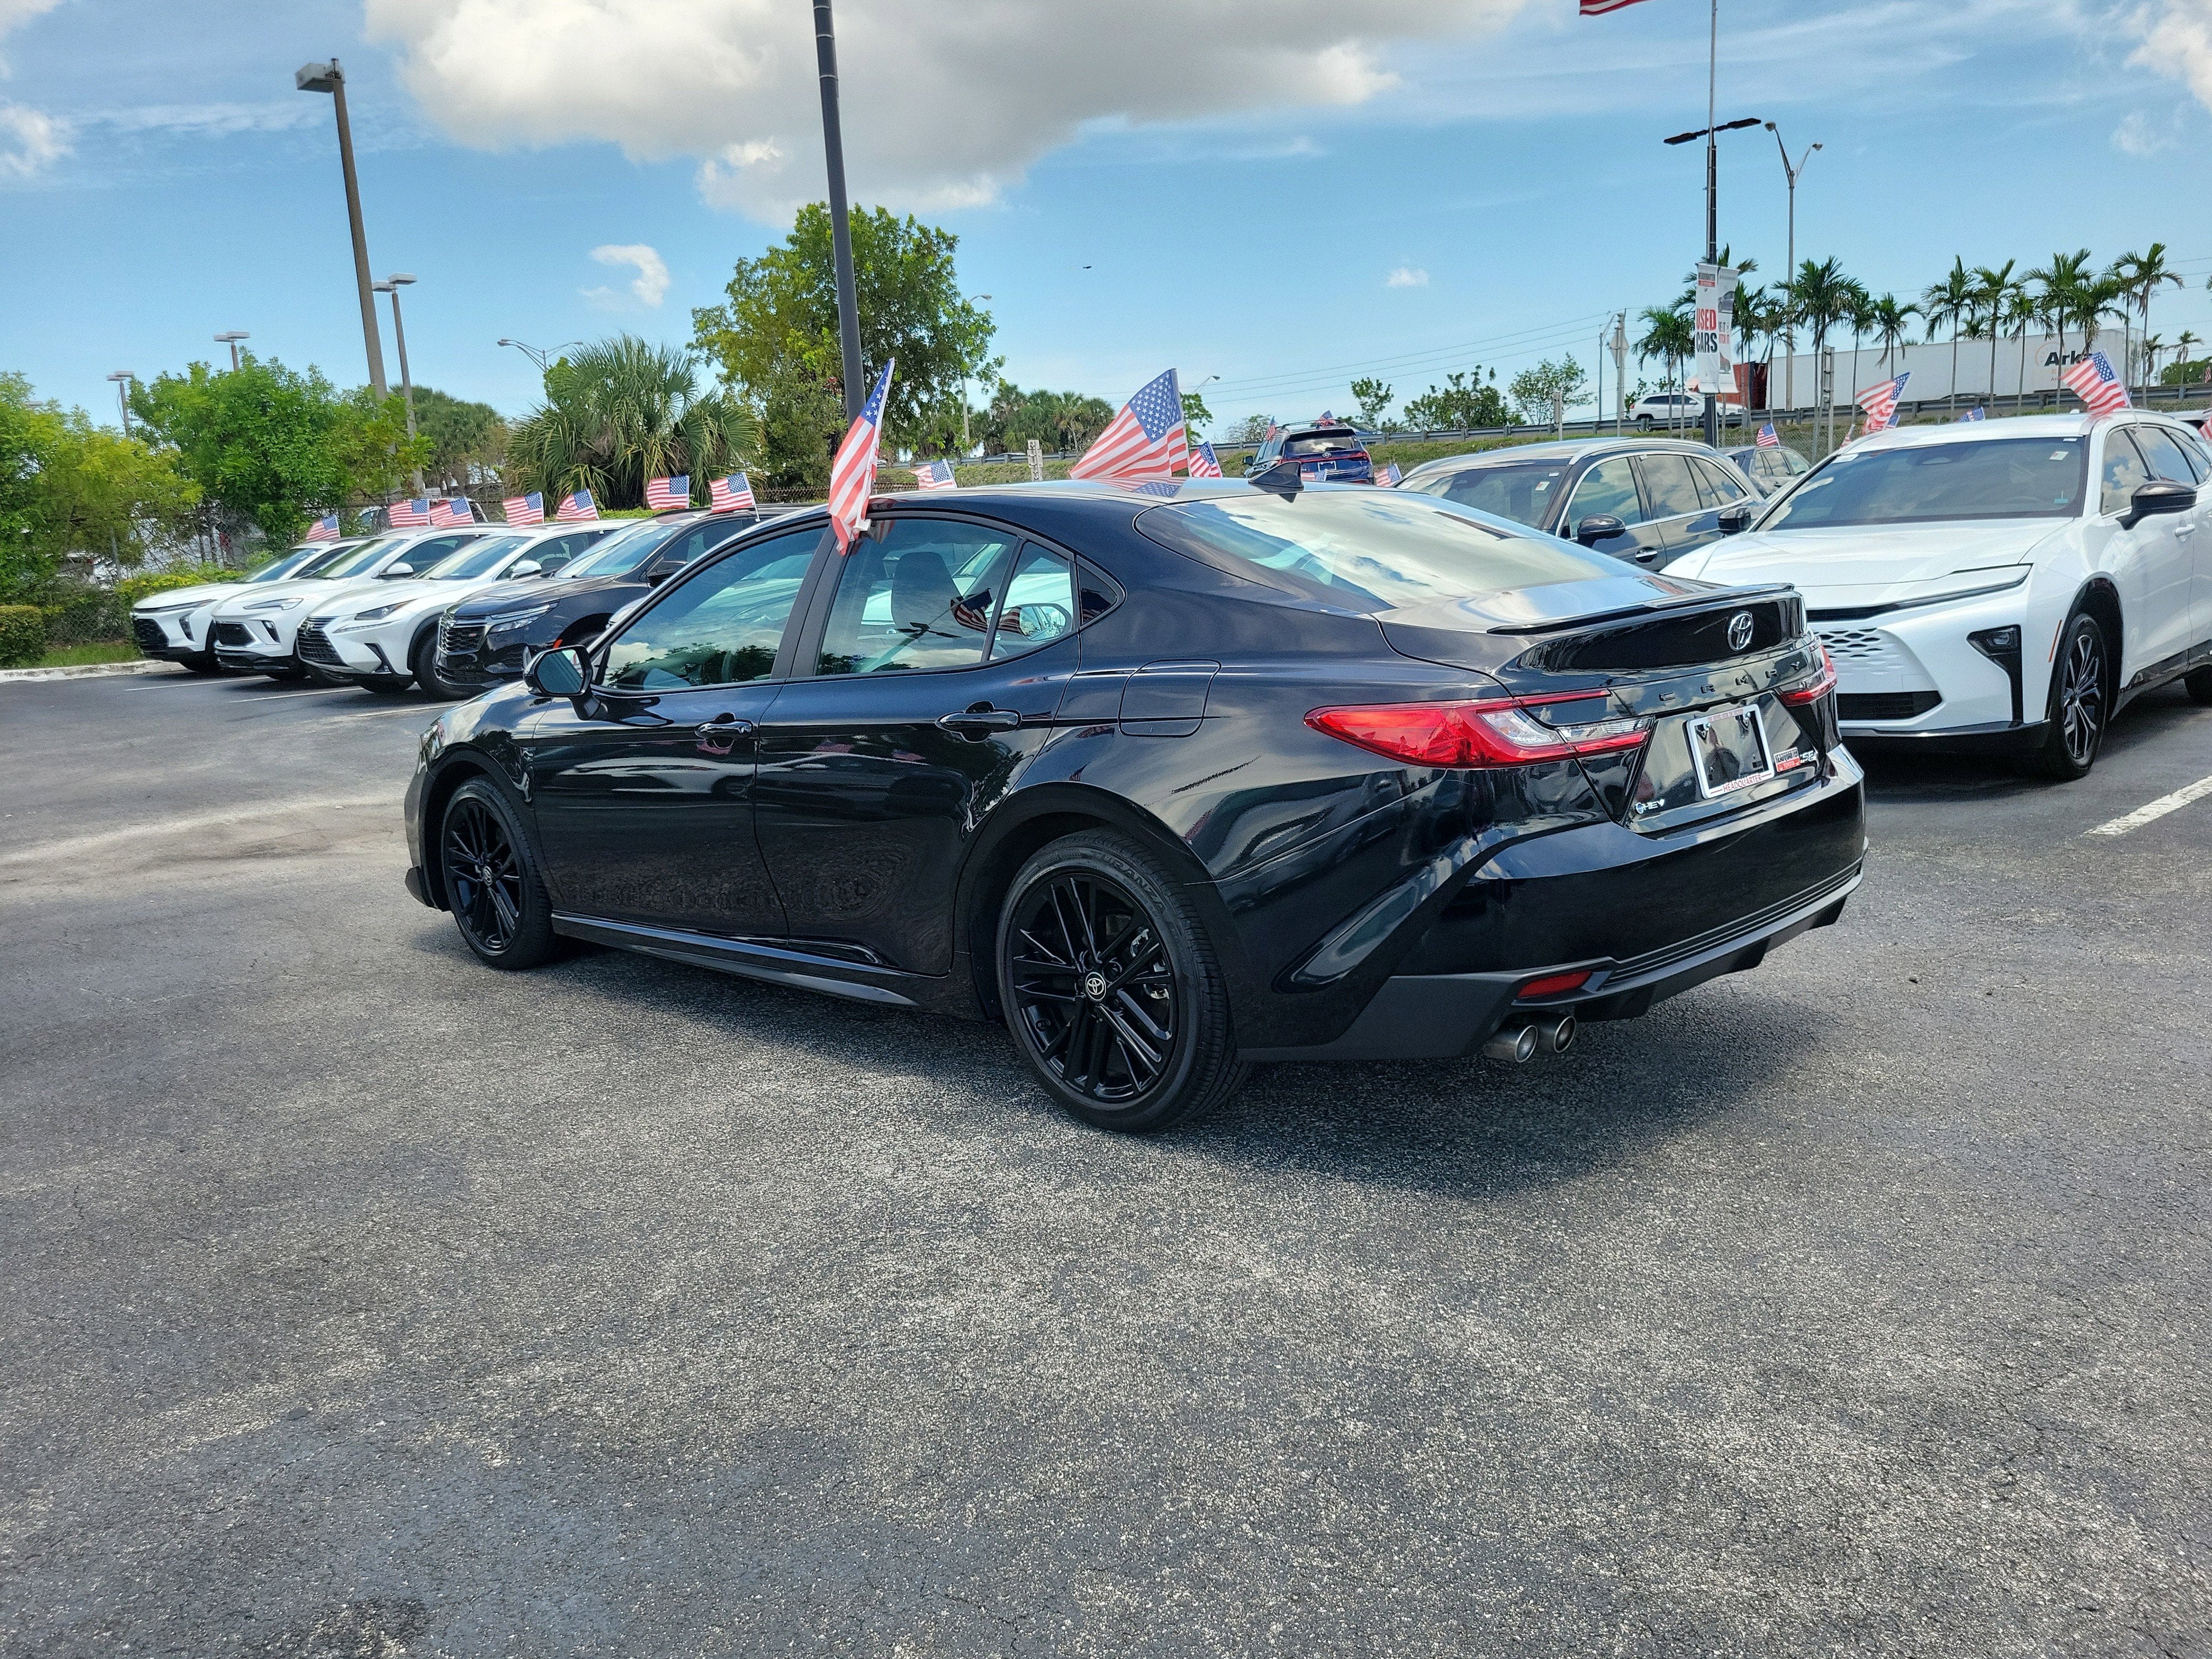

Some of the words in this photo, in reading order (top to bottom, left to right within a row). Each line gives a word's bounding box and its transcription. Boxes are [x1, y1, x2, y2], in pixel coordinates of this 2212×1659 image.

[1696, 308, 1716, 331] USED
[1696, 332, 1718, 353] CARS
[1659, 660, 1801, 702] CAMRY
[1723, 774, 1762, 792] HEADQUARTER
[1091, 851, 1166, 913] TURANZA
